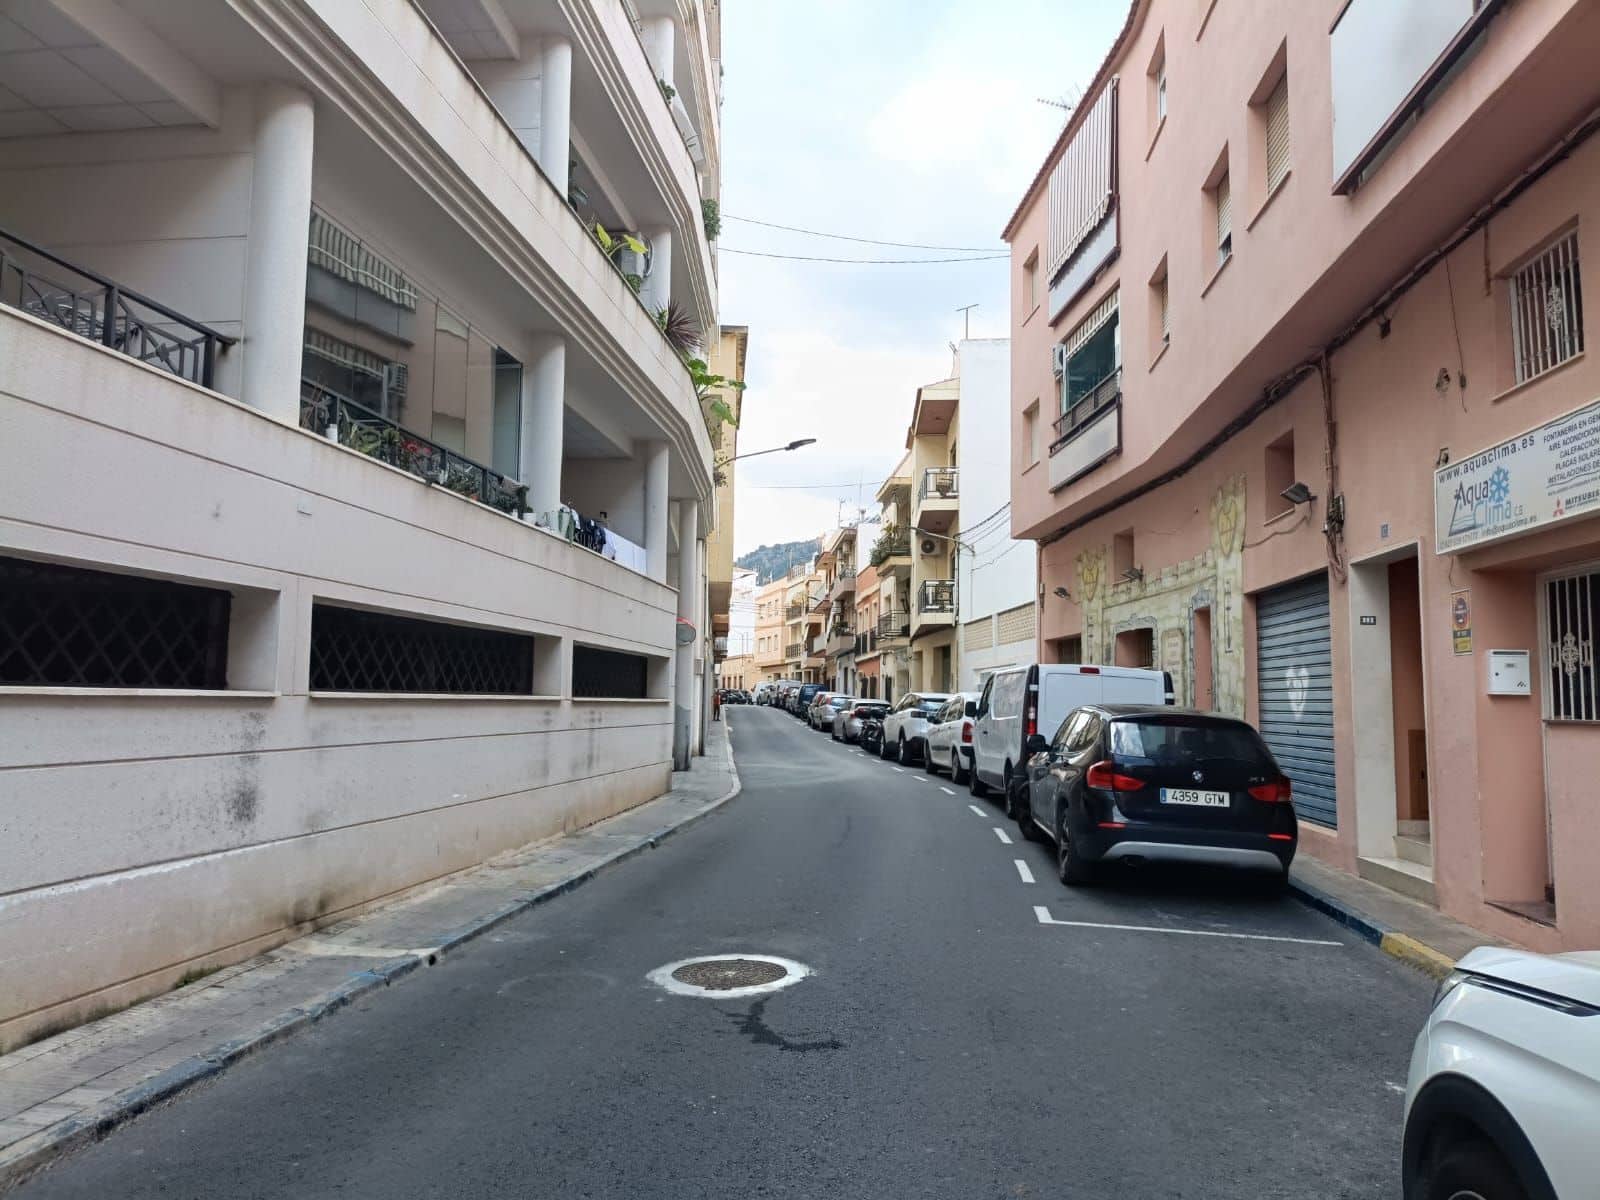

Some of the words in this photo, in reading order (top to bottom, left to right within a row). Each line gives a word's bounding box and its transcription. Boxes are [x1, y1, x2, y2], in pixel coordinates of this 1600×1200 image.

[1578, 418, 1587, 429] EN
[1548, 441, 1561, 451] AIRE
[1438, 434, 1536, 484] www.aquaclima.es
[1555, 454, 1578, 471] PLACAS
[1547, 461, 1592, 484] INSTALACIONES
[1454, 478, 1489, 510] Aqua
[1474, 499, 1512, 527] Clima
[1171, 790, 1199, 803] 4359
[1204, 793, 1225, 805] GTM
